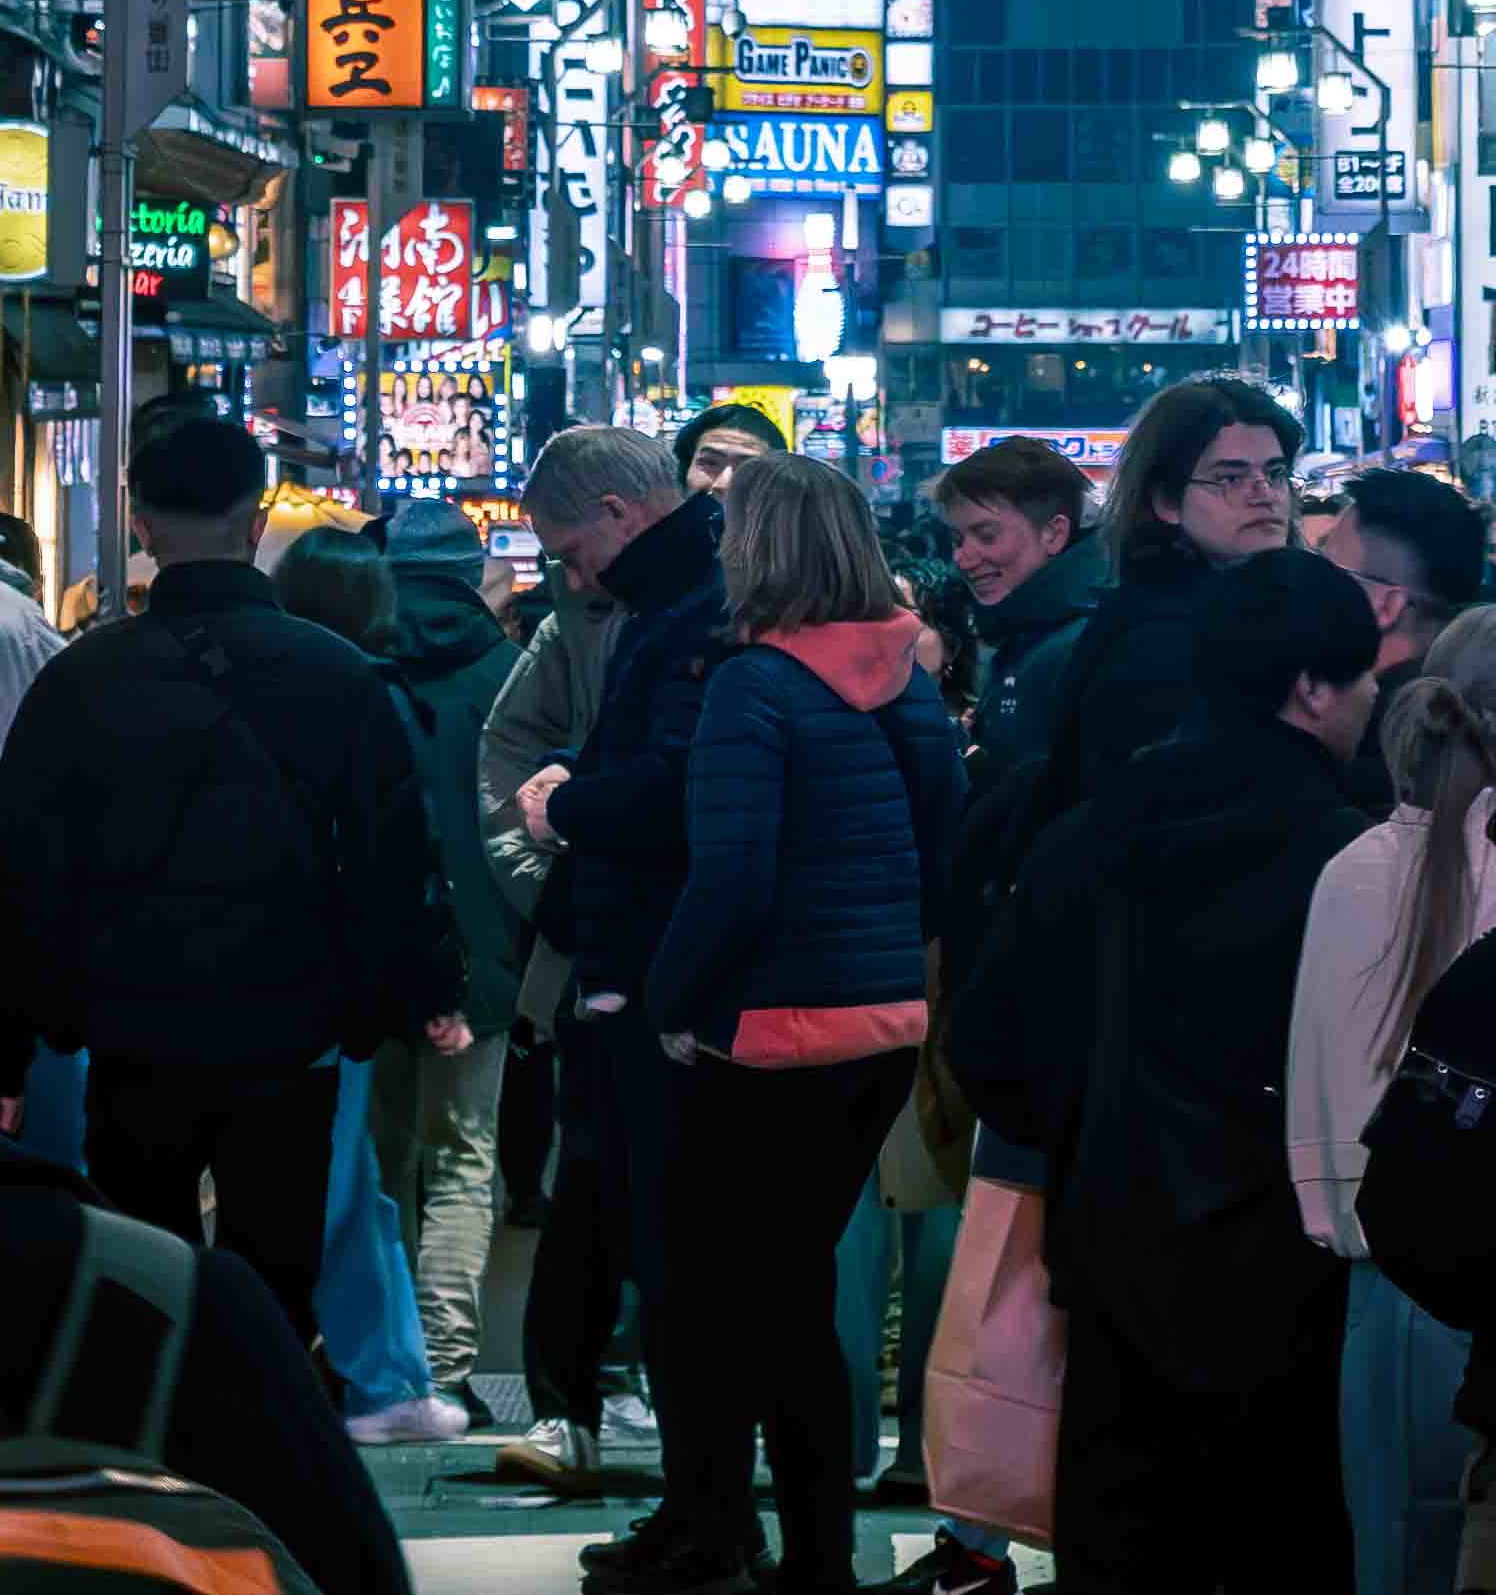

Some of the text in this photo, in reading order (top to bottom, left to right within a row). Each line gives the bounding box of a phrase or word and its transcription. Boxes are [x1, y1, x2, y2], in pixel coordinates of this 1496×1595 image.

[795, 40, 850, 81] PANIC
[725, 120, 881, 173] SAUNA
[1262, 249, 1359, 281] 24時間
[1261, 284, 1358, 315] 営業中
